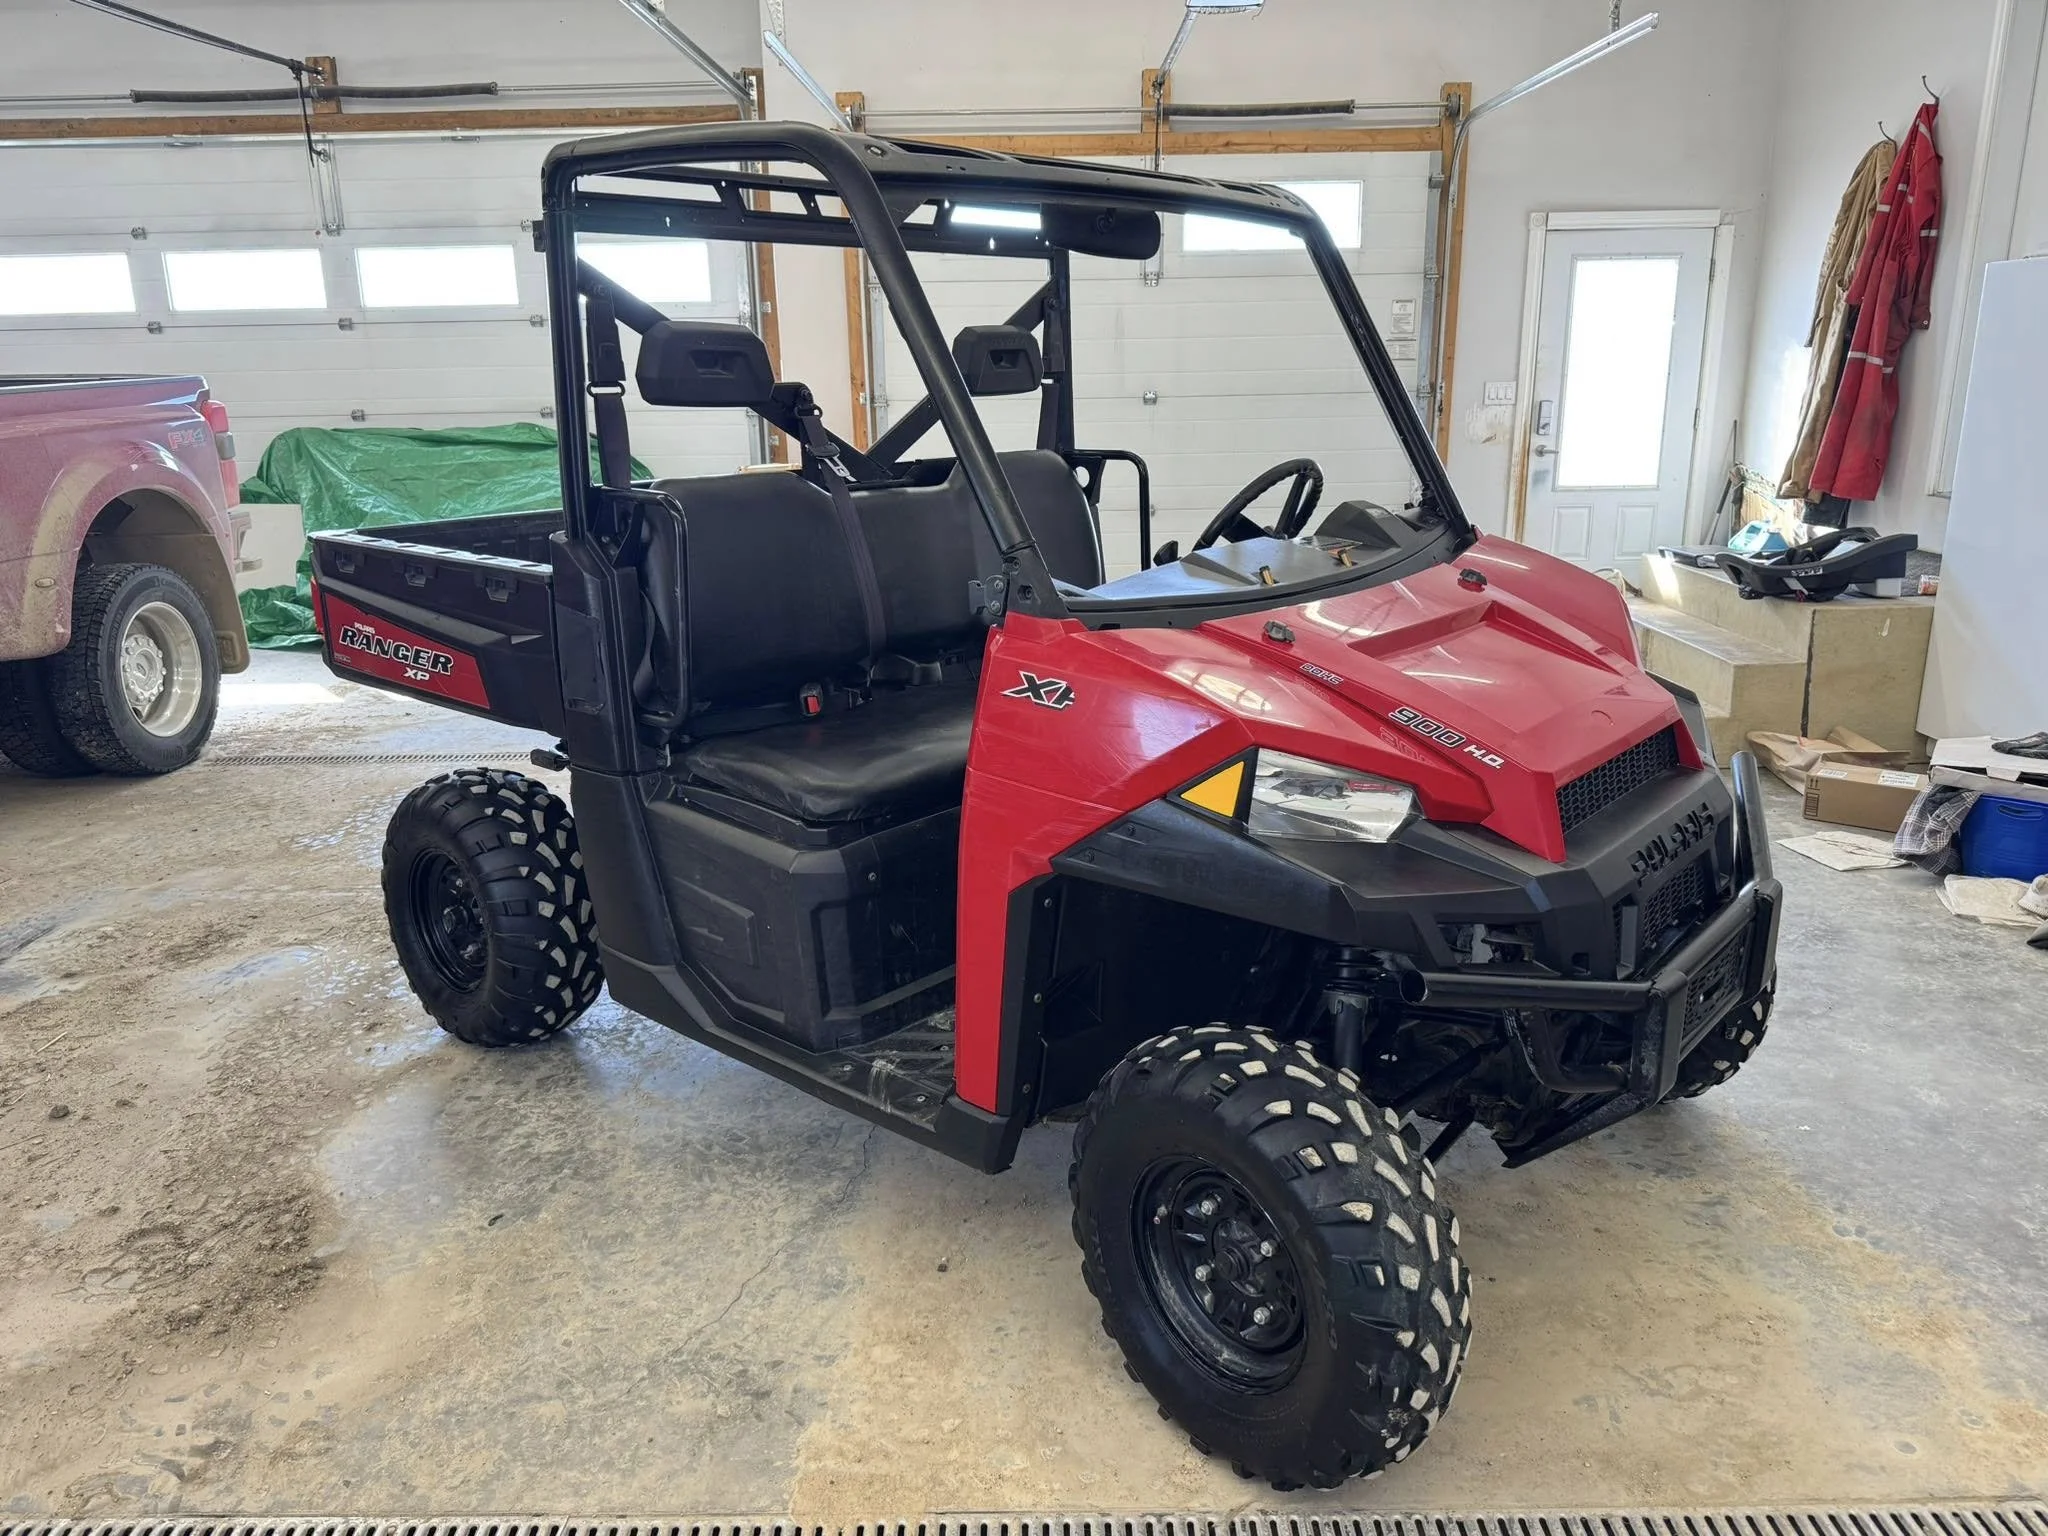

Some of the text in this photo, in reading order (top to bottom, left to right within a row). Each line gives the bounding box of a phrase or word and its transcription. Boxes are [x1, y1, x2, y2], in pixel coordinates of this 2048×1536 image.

[339, 625, 454, 676] RANGER
[403, 666, 430, 681] XP
[1388, 706, 1466, 748] 900
[1629, 801, 1715, 888] POLARIS
